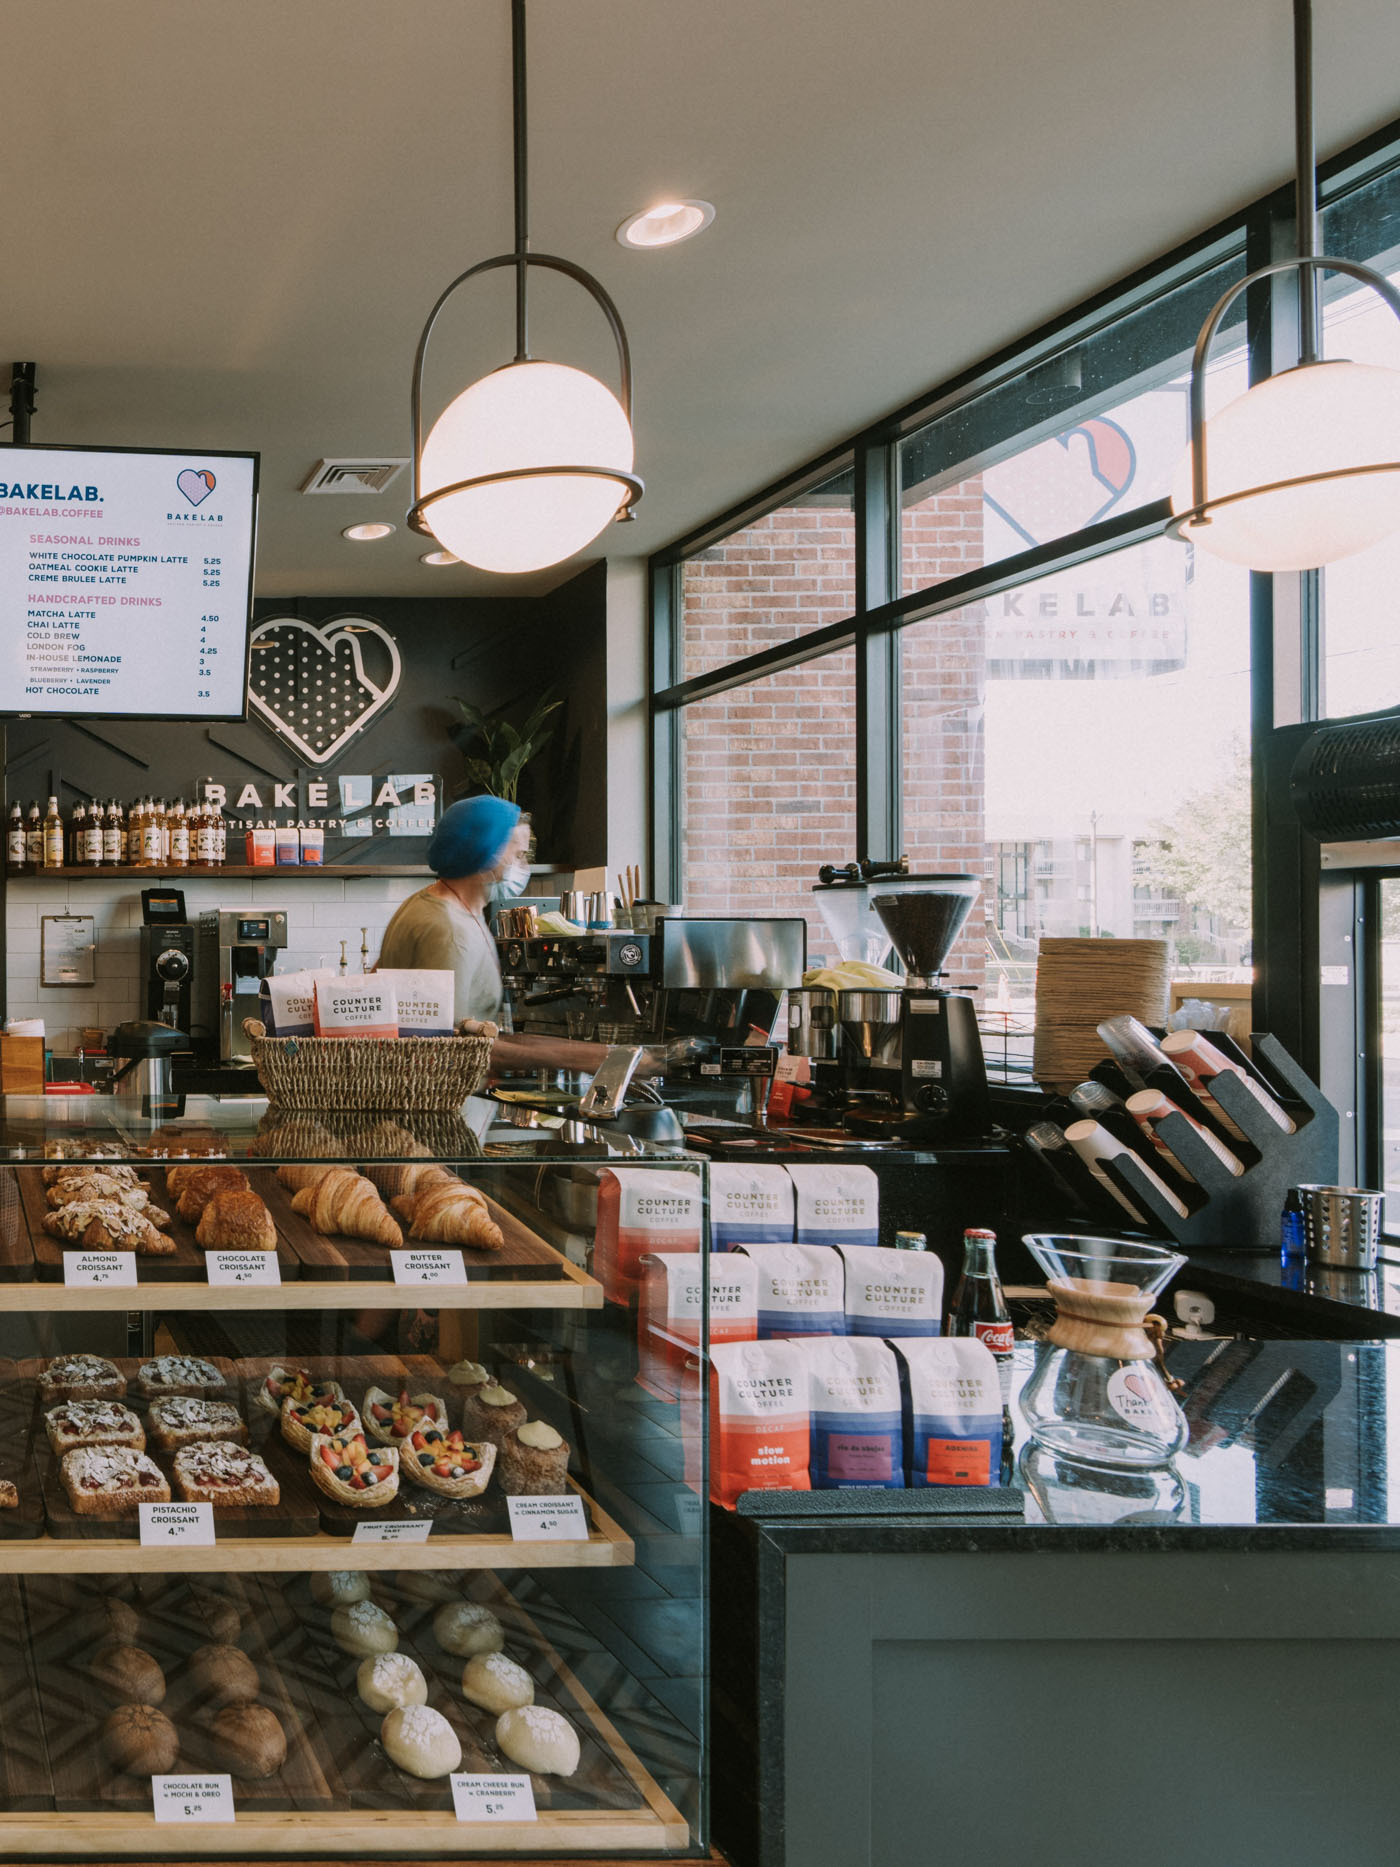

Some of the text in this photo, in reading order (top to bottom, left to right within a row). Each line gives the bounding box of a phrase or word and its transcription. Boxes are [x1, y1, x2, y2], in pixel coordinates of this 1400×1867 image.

[167, 513, 223, 521] BAKELAB
[30, 535, 140, 547] SEASONAL DRINKS
[29, 552, 58, 560] WHITE
[61, 553, 114, 562] CHOCOLATE
[118, 554, 158, 563] PUMPKIN
[161, 556, 188, 564] LATTE
[29, 563, 71, 571] OATMEAL
[75, 564, 108, 572] COOKIE
[111, 565, 139, 573] LATTE
[28, 574, 58, 582] CREME
[62, 575, 96, 583] BRULEE
[99, 576, 127, 584] LATTE
[28, 594, 162, 607] HANDCRAFTED DRINKS
[28, 610, 65, 618] MATCHA
[68, 611, 96, 619] LATTE
[27, 621, 49, 629] CHAI
[27, 643, 64, 651] LONDON
[26, 654, 69, 662] IN-HOUSE
[73, 655, 122, 663] LEMONADE
[26, 686, 43, 694] HOT
[47, 687, 99, 695] CHOCOLATE
[204, 782, 436, 808] BAKELAB
[287, 818, 436, 829] PASTRY COFFEE
[333, 997, 382, 1006] COUNTER
[398, 1001, 439, 1009] OUNTER
[333, 1005, 382, 1014] CULTURE
[398, 1009, 439, 1017] ULTURE
[726, 1192, 779, 1201] COUNTER
[726, 1201, 779, 1210] CULTURE
[815, 1199, 865, 1207] COUNTER
[637, 1207, 690, 1215] CULTURE
[814, 1207, 865, 1216] CULTURE
[93, 1274, 109, 1282] 4.75
[235, 1273, 252, 1281] 4.50
[771, 1279, 829, 1287] COUNTER
[772, 1288, 829, 1297] CULTURE
[865, 1285, 925, 1295] COUNTER
[865, 1294, 924, 1304] CULTURE
[879, 1305, 912, 1313] COFFEE
[737, 1378, 793, 1388] COUNTER
[739, 1389, 793, 1398] CULTURE
[758, 1446, 783, 1455] slow
[751, 1455, 790, 1466] motion
[540, 1521, 557, 1530] 4.50
[168, 1527, 184, 1536] 4.75
